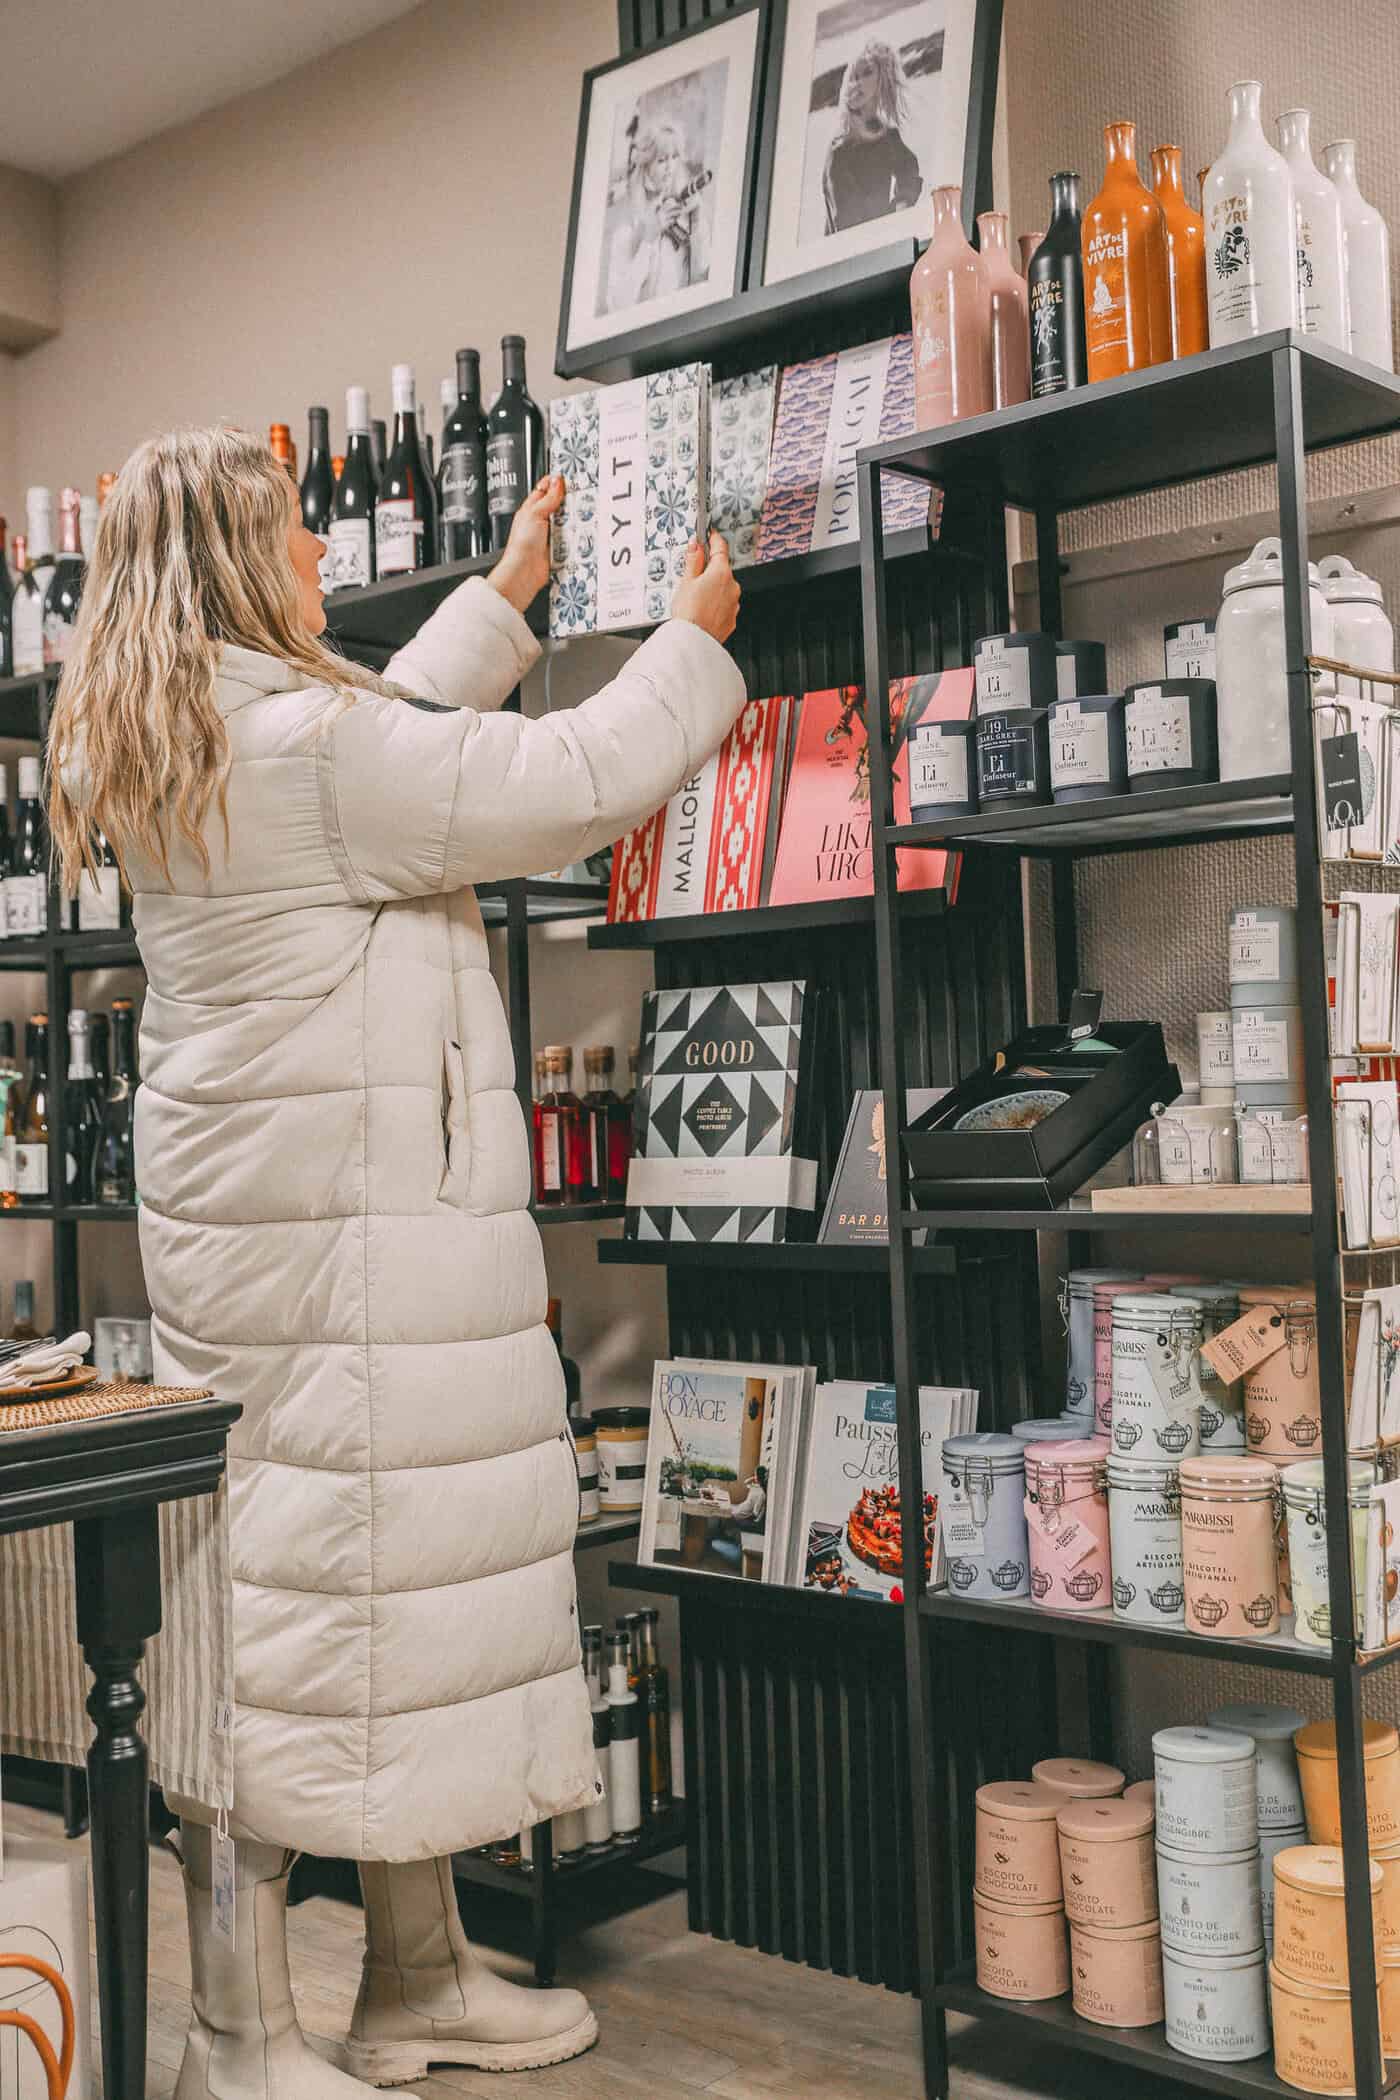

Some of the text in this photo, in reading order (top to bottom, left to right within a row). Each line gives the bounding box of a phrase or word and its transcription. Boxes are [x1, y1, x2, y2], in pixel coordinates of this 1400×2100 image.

[1089, 232, 1111, 252] ART
[1087, 244, 1128, 266] VIVRE
[1032, 280, 1051, 298] ART
[1031, 291, 1064, 312] VIVRE
[611, 456, 633, 567] SYLT
[989, 720, 1002, 734] 19
[685, 1040, 755, 1066] GOOD
[838, 1214, 867, 1226] BAR
[659, 1374, 699, 1397] BON
[659, 1390, 728, 1423] VOYAGE
[835, 1414, 933, 1448] Patisse
